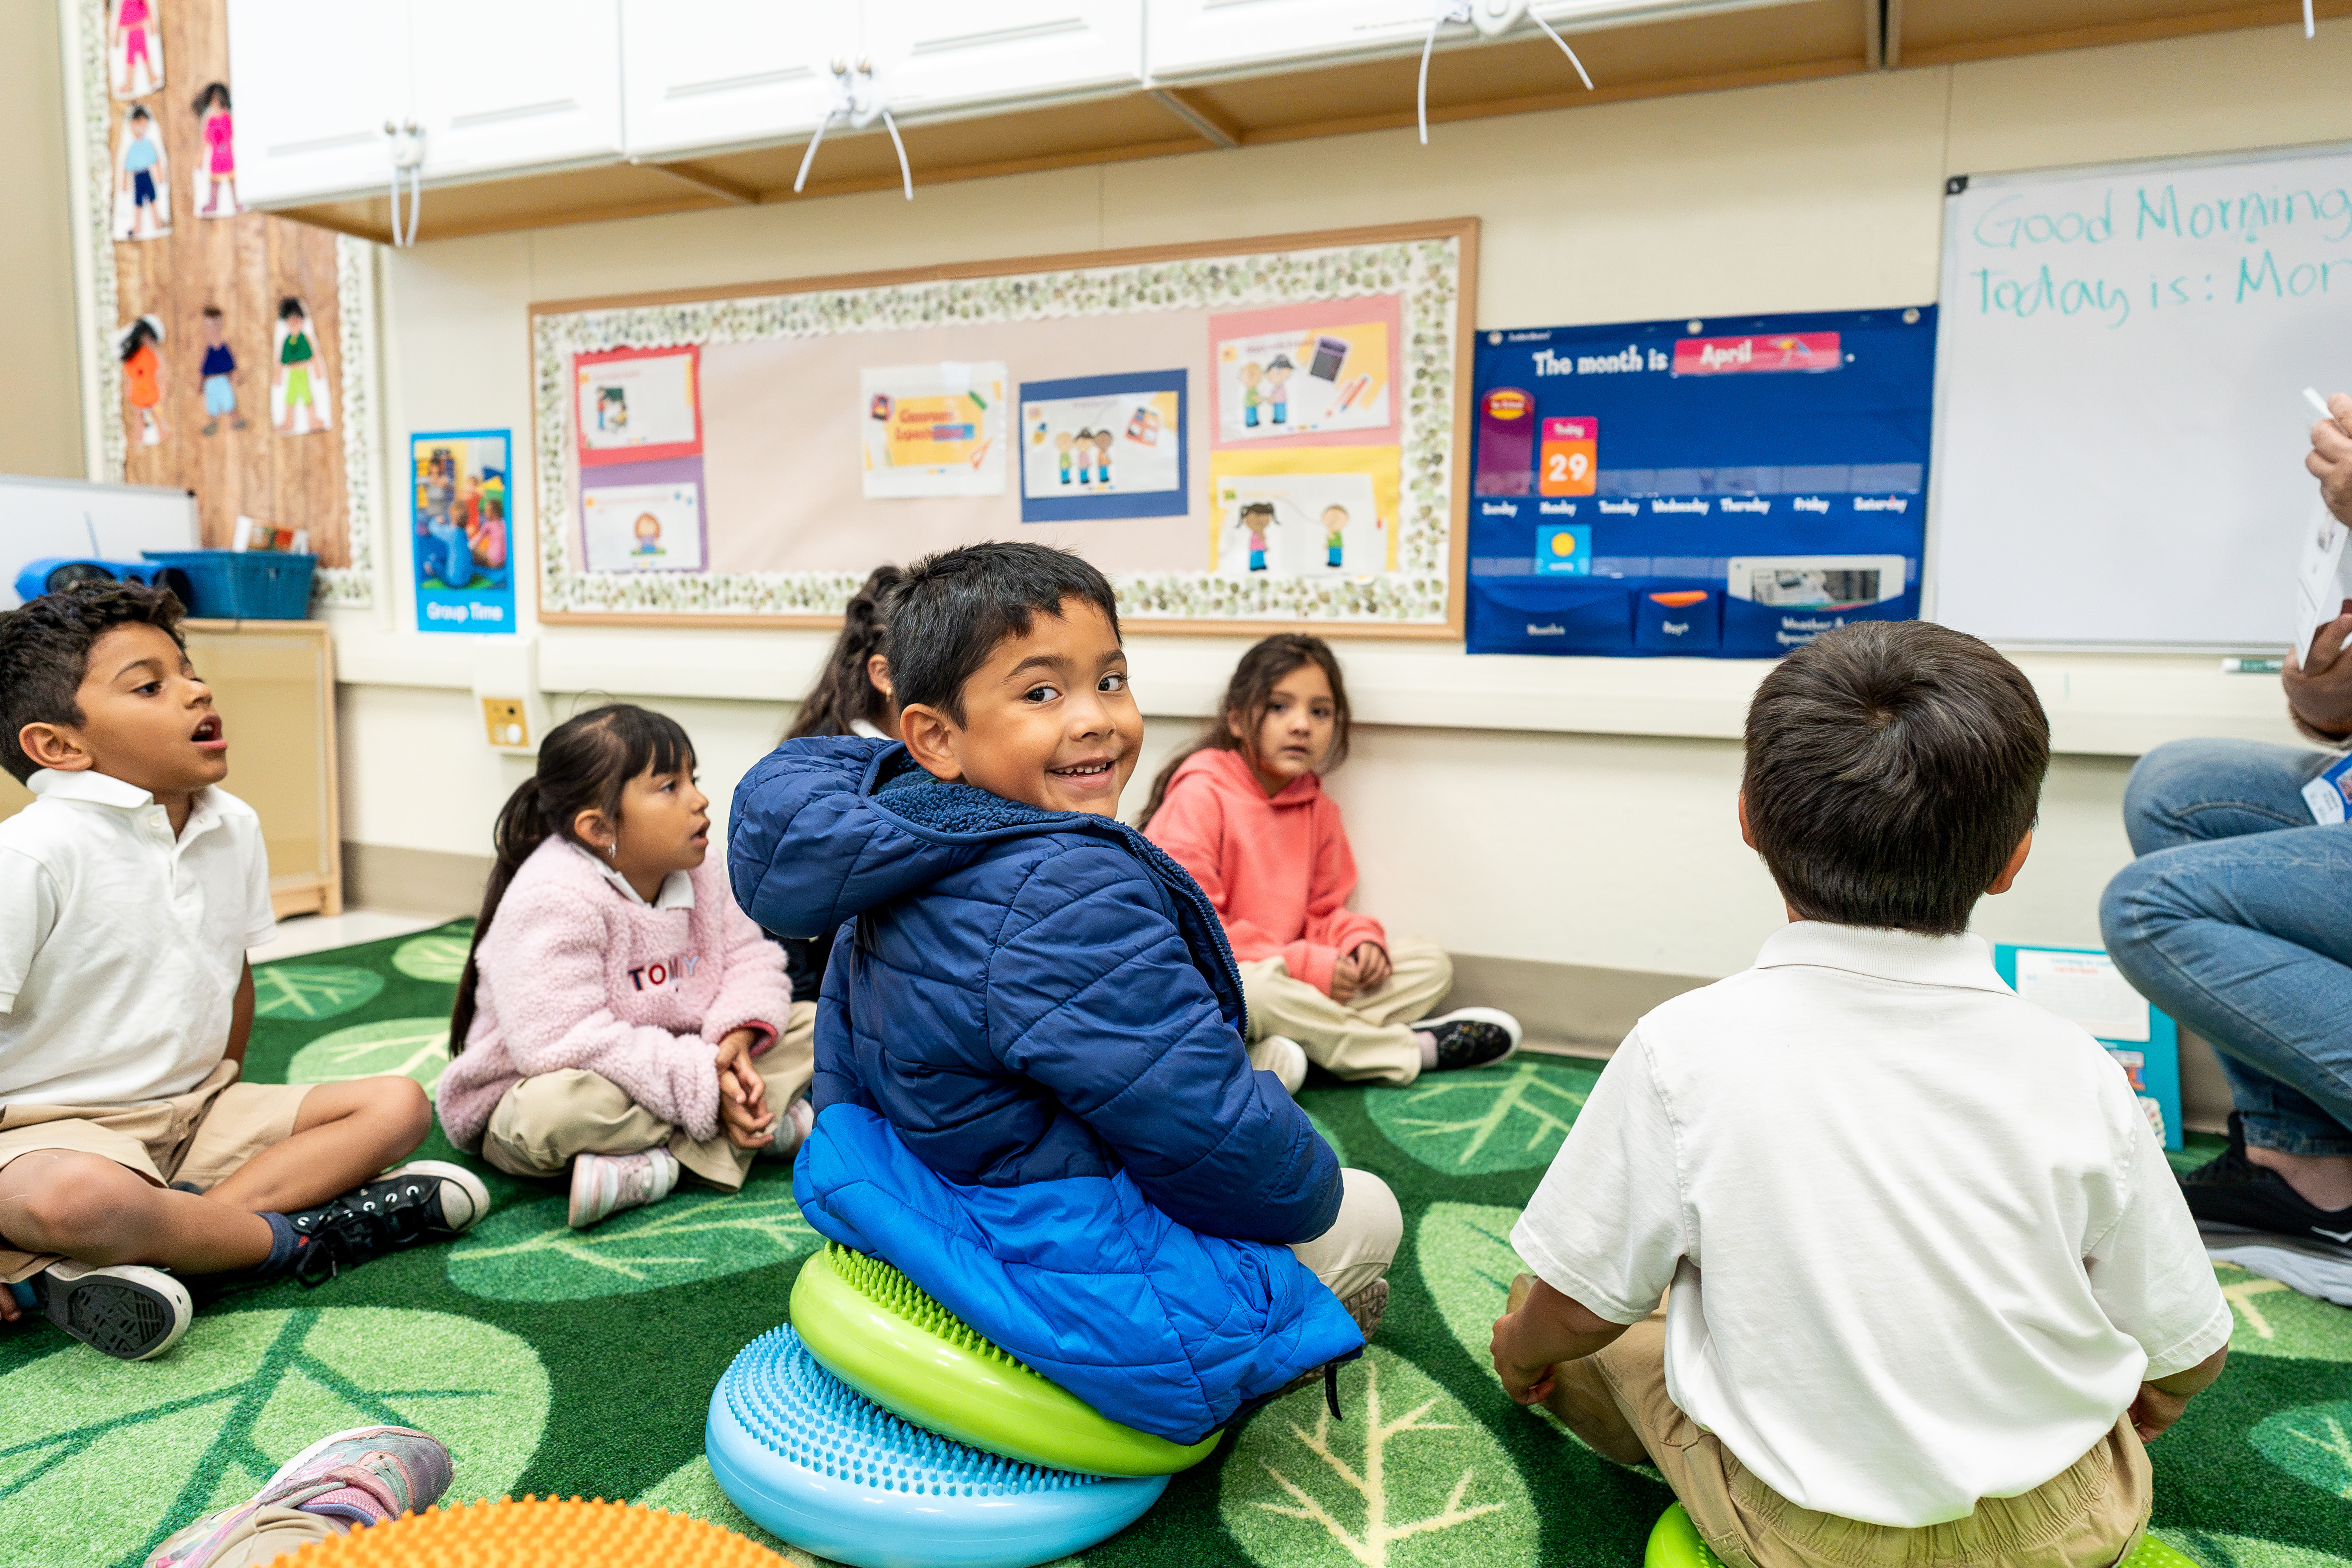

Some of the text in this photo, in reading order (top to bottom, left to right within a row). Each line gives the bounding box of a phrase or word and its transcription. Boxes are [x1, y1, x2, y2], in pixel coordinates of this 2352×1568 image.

[1972, 183, 2352, 249] Good Morning
[1971, 264, 2132, 329] Today
[1532, 338, 1752, 377] The month is April
[1548, 453, 1588, 482] 29
[1482, 494, 1908, 518] Sunday Monday Tuesday Wednesday Thursday Friday Saturday
[426, 601, 504, 624] Group Time
